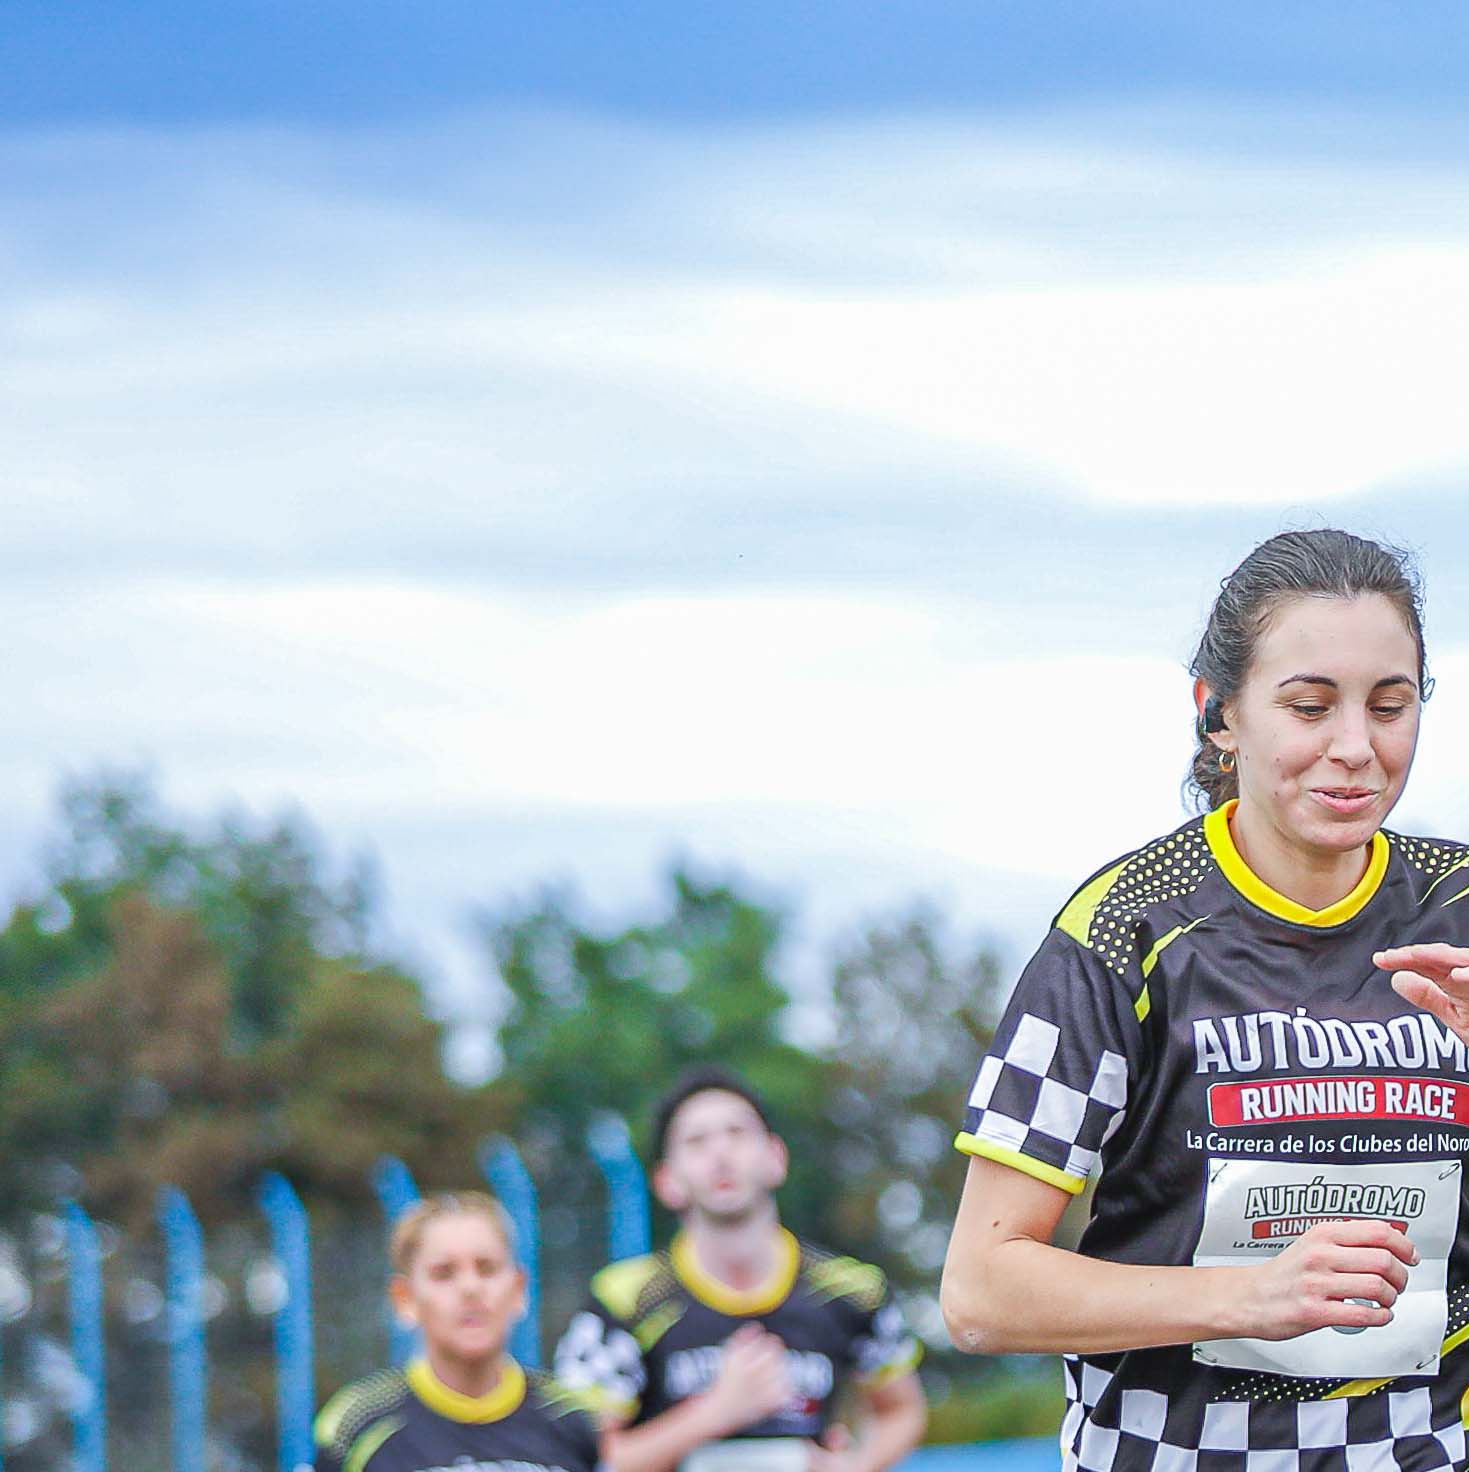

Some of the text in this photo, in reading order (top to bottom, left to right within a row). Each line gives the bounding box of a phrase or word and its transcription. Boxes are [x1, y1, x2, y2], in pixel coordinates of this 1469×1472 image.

[1240, 1081, 1456, 1121] RUNNING RACE
[1186, 1129, 1203, 1150] La
[1206, 1132, 1274, 1153] Carrera
[1279, 1134, 1304, 1153] de
[1308, 1134, 1336, 1153] los
[1340, 1134, 1402, 1153] Clubes
[1406, 1133, 1433, 1152] del
[1244, 1176, 1427, 1219] AUTÓDROMO
[1271, 1217, 1344, 1236] RUNN
[1232, 1240, 1245, 1249] La
[1246, 1240, 1285, 1249] Carrera
